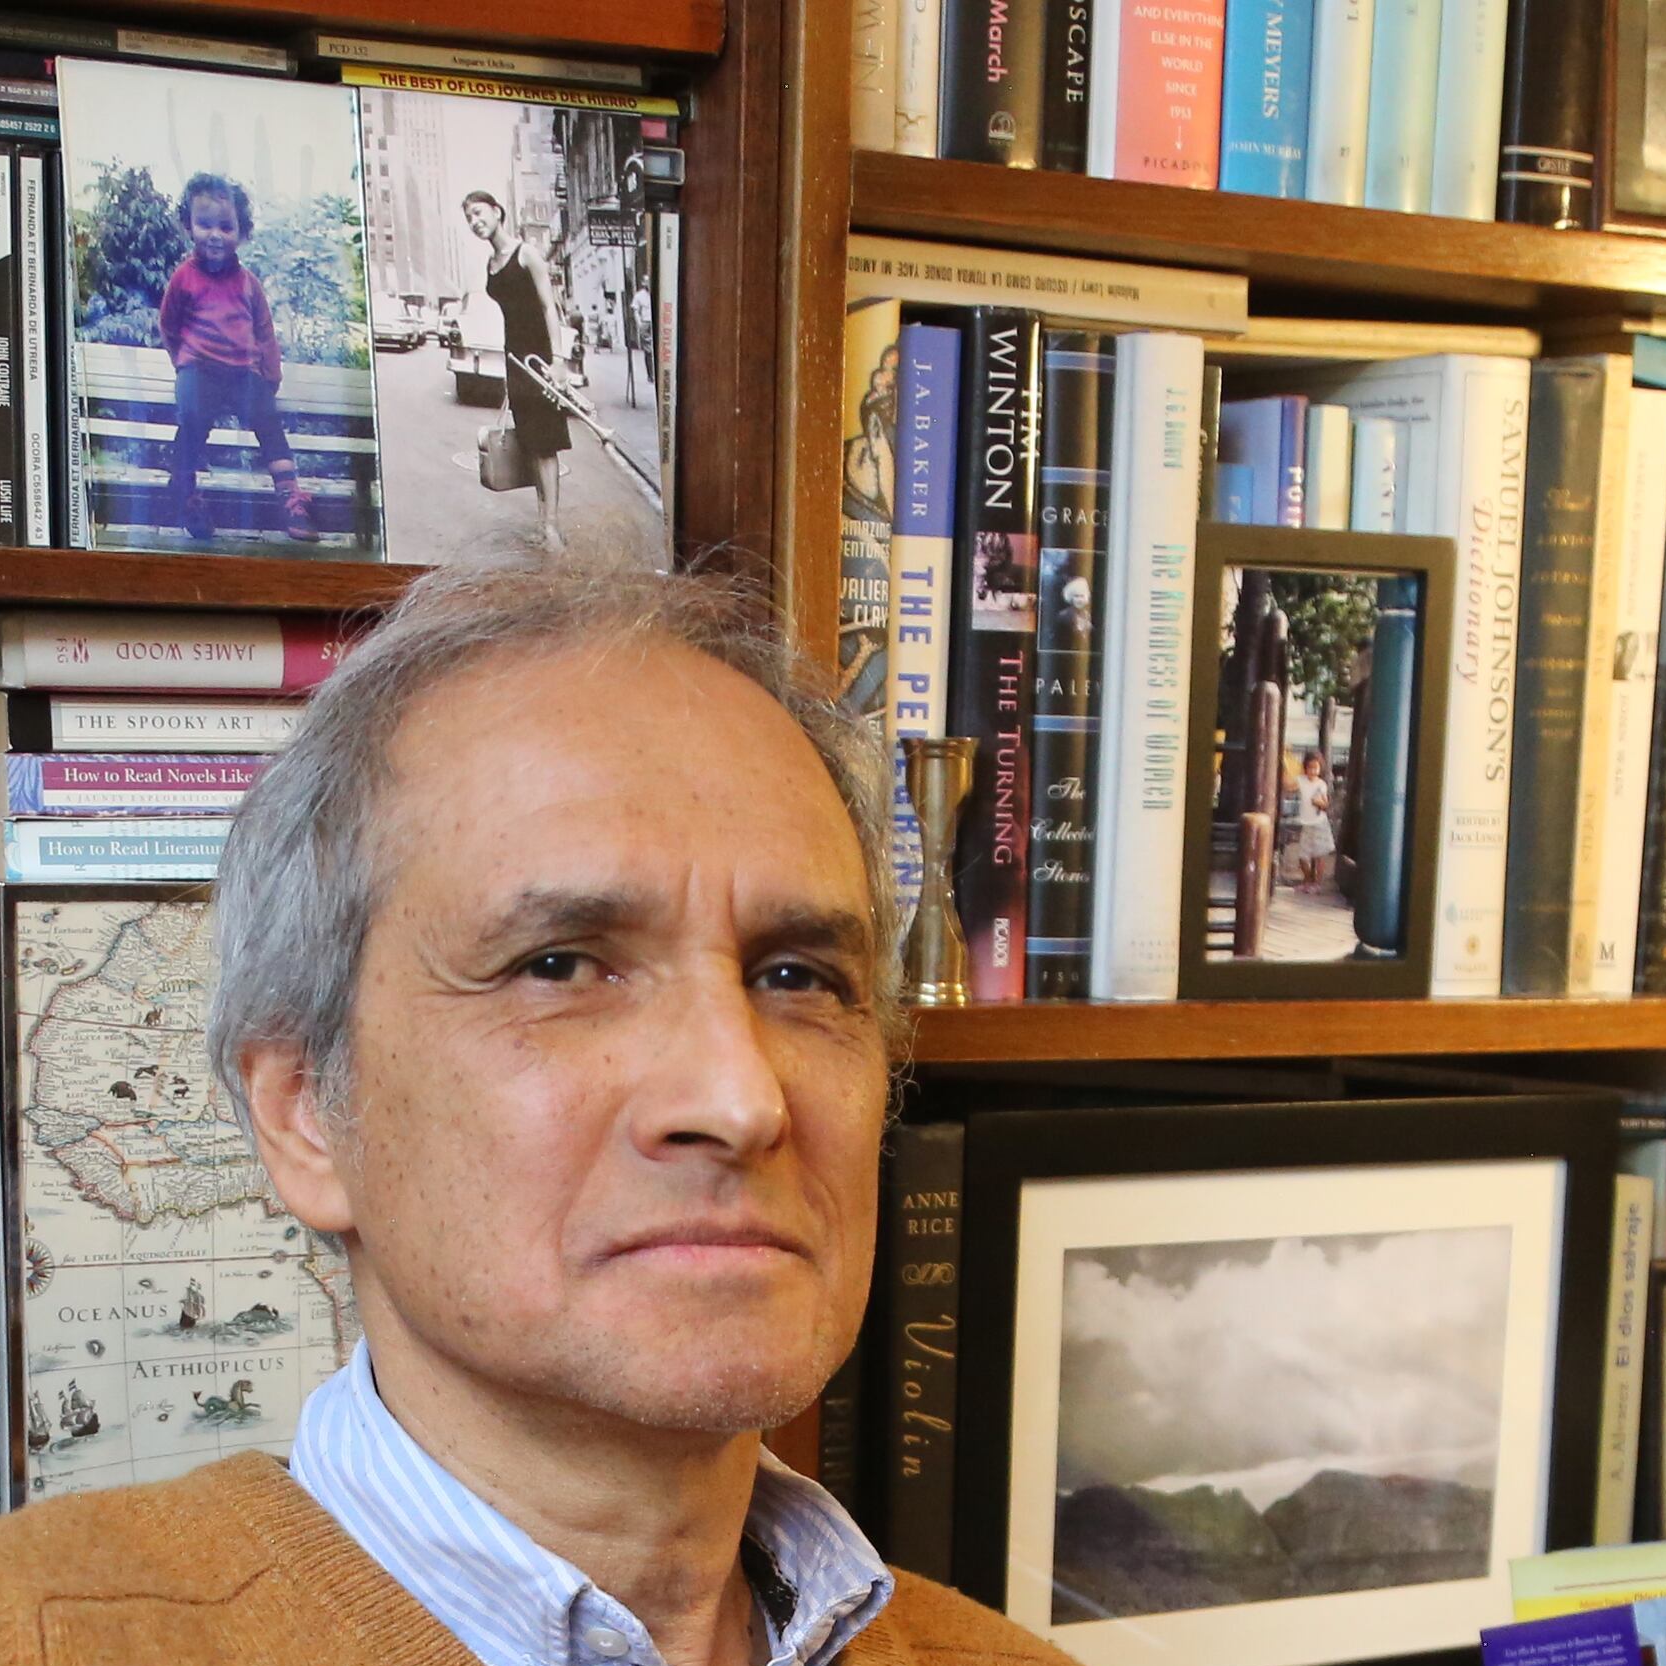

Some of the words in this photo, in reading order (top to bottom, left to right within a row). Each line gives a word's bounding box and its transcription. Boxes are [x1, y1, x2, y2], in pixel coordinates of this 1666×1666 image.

[1135, 7, 1160, 18] AND
[987, 0, 1008, 83] March
[1151, 31, 1177, 46] ELSE
[1179, 34, 1192, 46] IN
[1195, 37, 1213, 50] THE
[1161, 55, 1203, 73] WORLD
[1262, 13, 1282, 120] MEYERS
[380, 72, 406, 86] THE
[410, 76, 445, 89] BEST
[447, 78, 466, 91] OF
[469, 81, 495, 94] LOS
[560, 89, 585, 103] DEL
[587, 90, 637, 108] HIERRO
[1165, 82, 1197, 96] SINCE
[26, 179, 36, 238] FERNANDA
[27, 242, 36, 254] ET
[27, 258, 37, 317] BERNARDA
[29, 319, 37, 335] DE
[29, 338, 38, 382] UTRERA
[913, 359, 932, 375] J.
[915, 384, 931, 405] A.
[985, 328, 1018, 509] WINTON
[912, 415, 931, 516] BAKER
[0, 480, 11, 502] LUSH
[1499, 397, 1526, 567] SAMUEL
[1, 503, 12, 523] LIFE
[1454, 499, 1488, 687] Dictionary
[899, 567, 933, 644] THE
[853, 606, 887, 628] CLAY
[117, 641, 183, 661] WOOD
[194, 642, 255, 661] JAMES
[998, 650, 1023, 713] THE
[1485, 572, 1522, 783] JOHNSON'S
[76, 714, 117, 729] THE
[127, 714, 208, 730] SPOOKY
[217, 715, 254, 730] ART
[64, 768, 100, 783] How
[105, 771, 120, 782] to
[124, 768, 162, 784] Read
[168, 768, 216, 783] Novels
[220, 769, 253, 783] Like
[994, 725, 1020, 865] TURNING
[48, 841, 85, 856] How
[89, 845, 105, 856] to
[110, 841, 149, 856] Read
[154, 841, 221, 856] Literatur
[993, 918, 1010, 968] PICADOR
[902, 1193, 958, 1210] ANNE
[908, 1218, 955, 1233] RICE
[1619, 1203, 1639, 1286] salvaje
[58, 1304, 167, 1323] OCEANUS
[1617, 1291, 1633, 1340] dios
[133, 1354, 285, 1378] AETHIOPICUS
[1616, 1347, 1630, 1368] El
[902, 1314, 957, 1476] Violin
